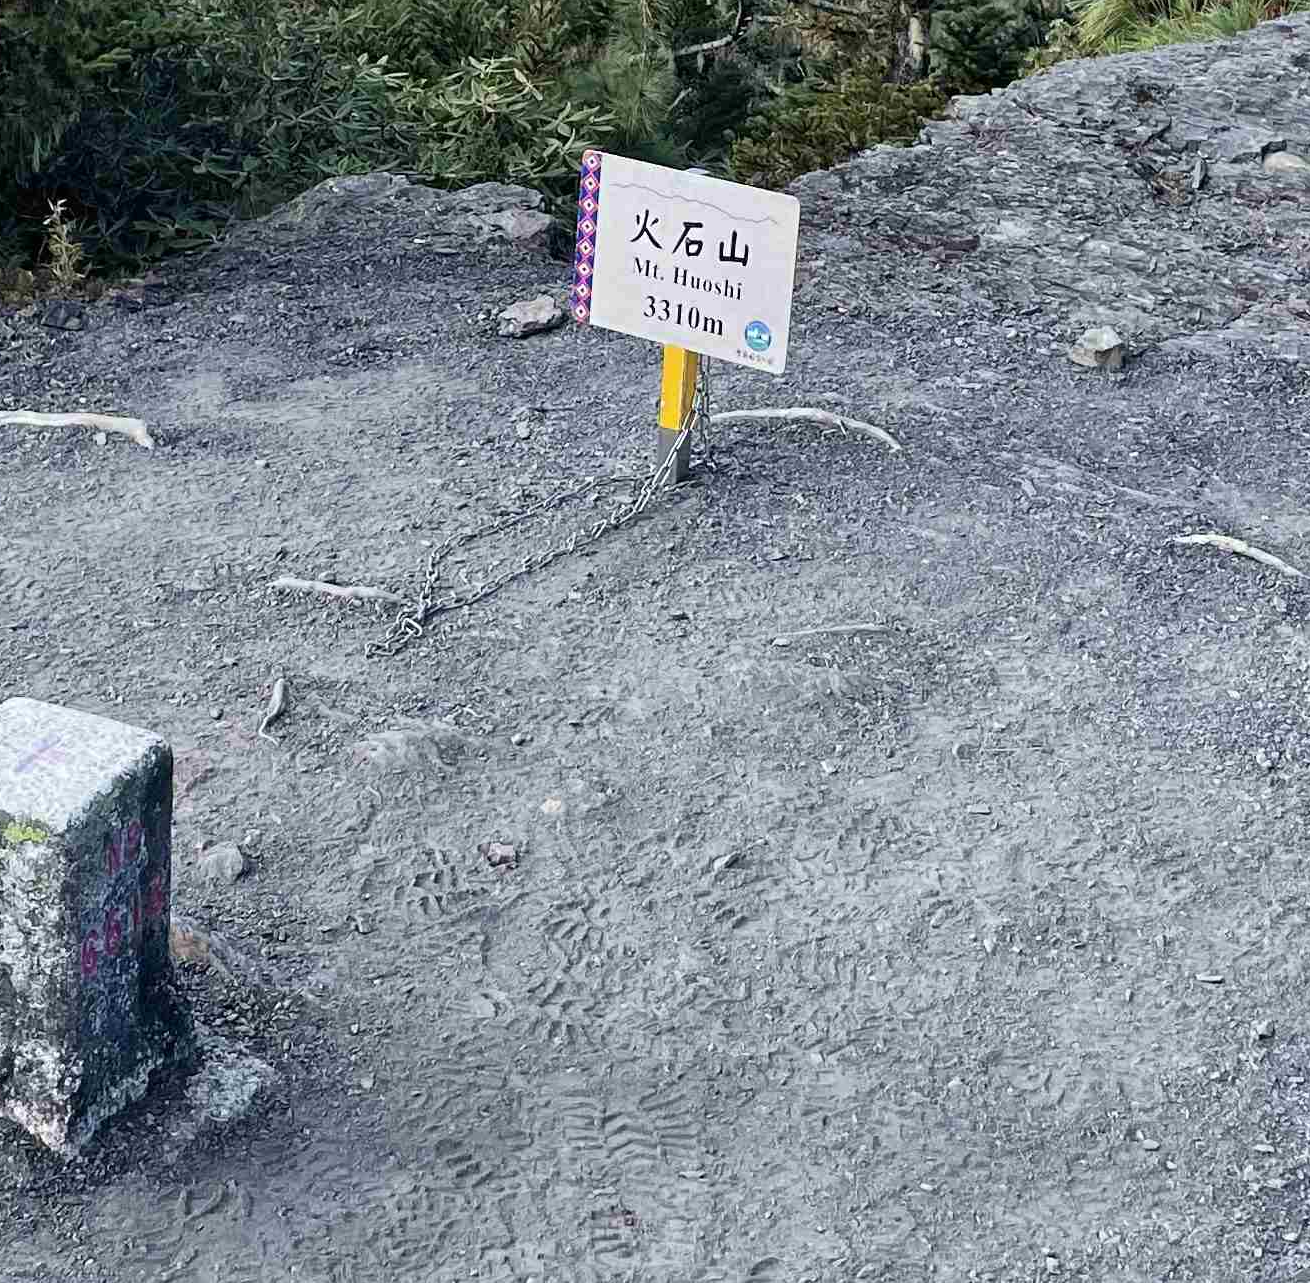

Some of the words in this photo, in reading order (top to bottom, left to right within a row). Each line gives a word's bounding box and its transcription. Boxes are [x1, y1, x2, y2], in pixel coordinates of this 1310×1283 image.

[630, 209, 749, 267] 火石山
[633, 257, 664, 282] Mt.
[673, 267, 743, 300] Huoshi
[643, 295, 724, 336] 3310m
